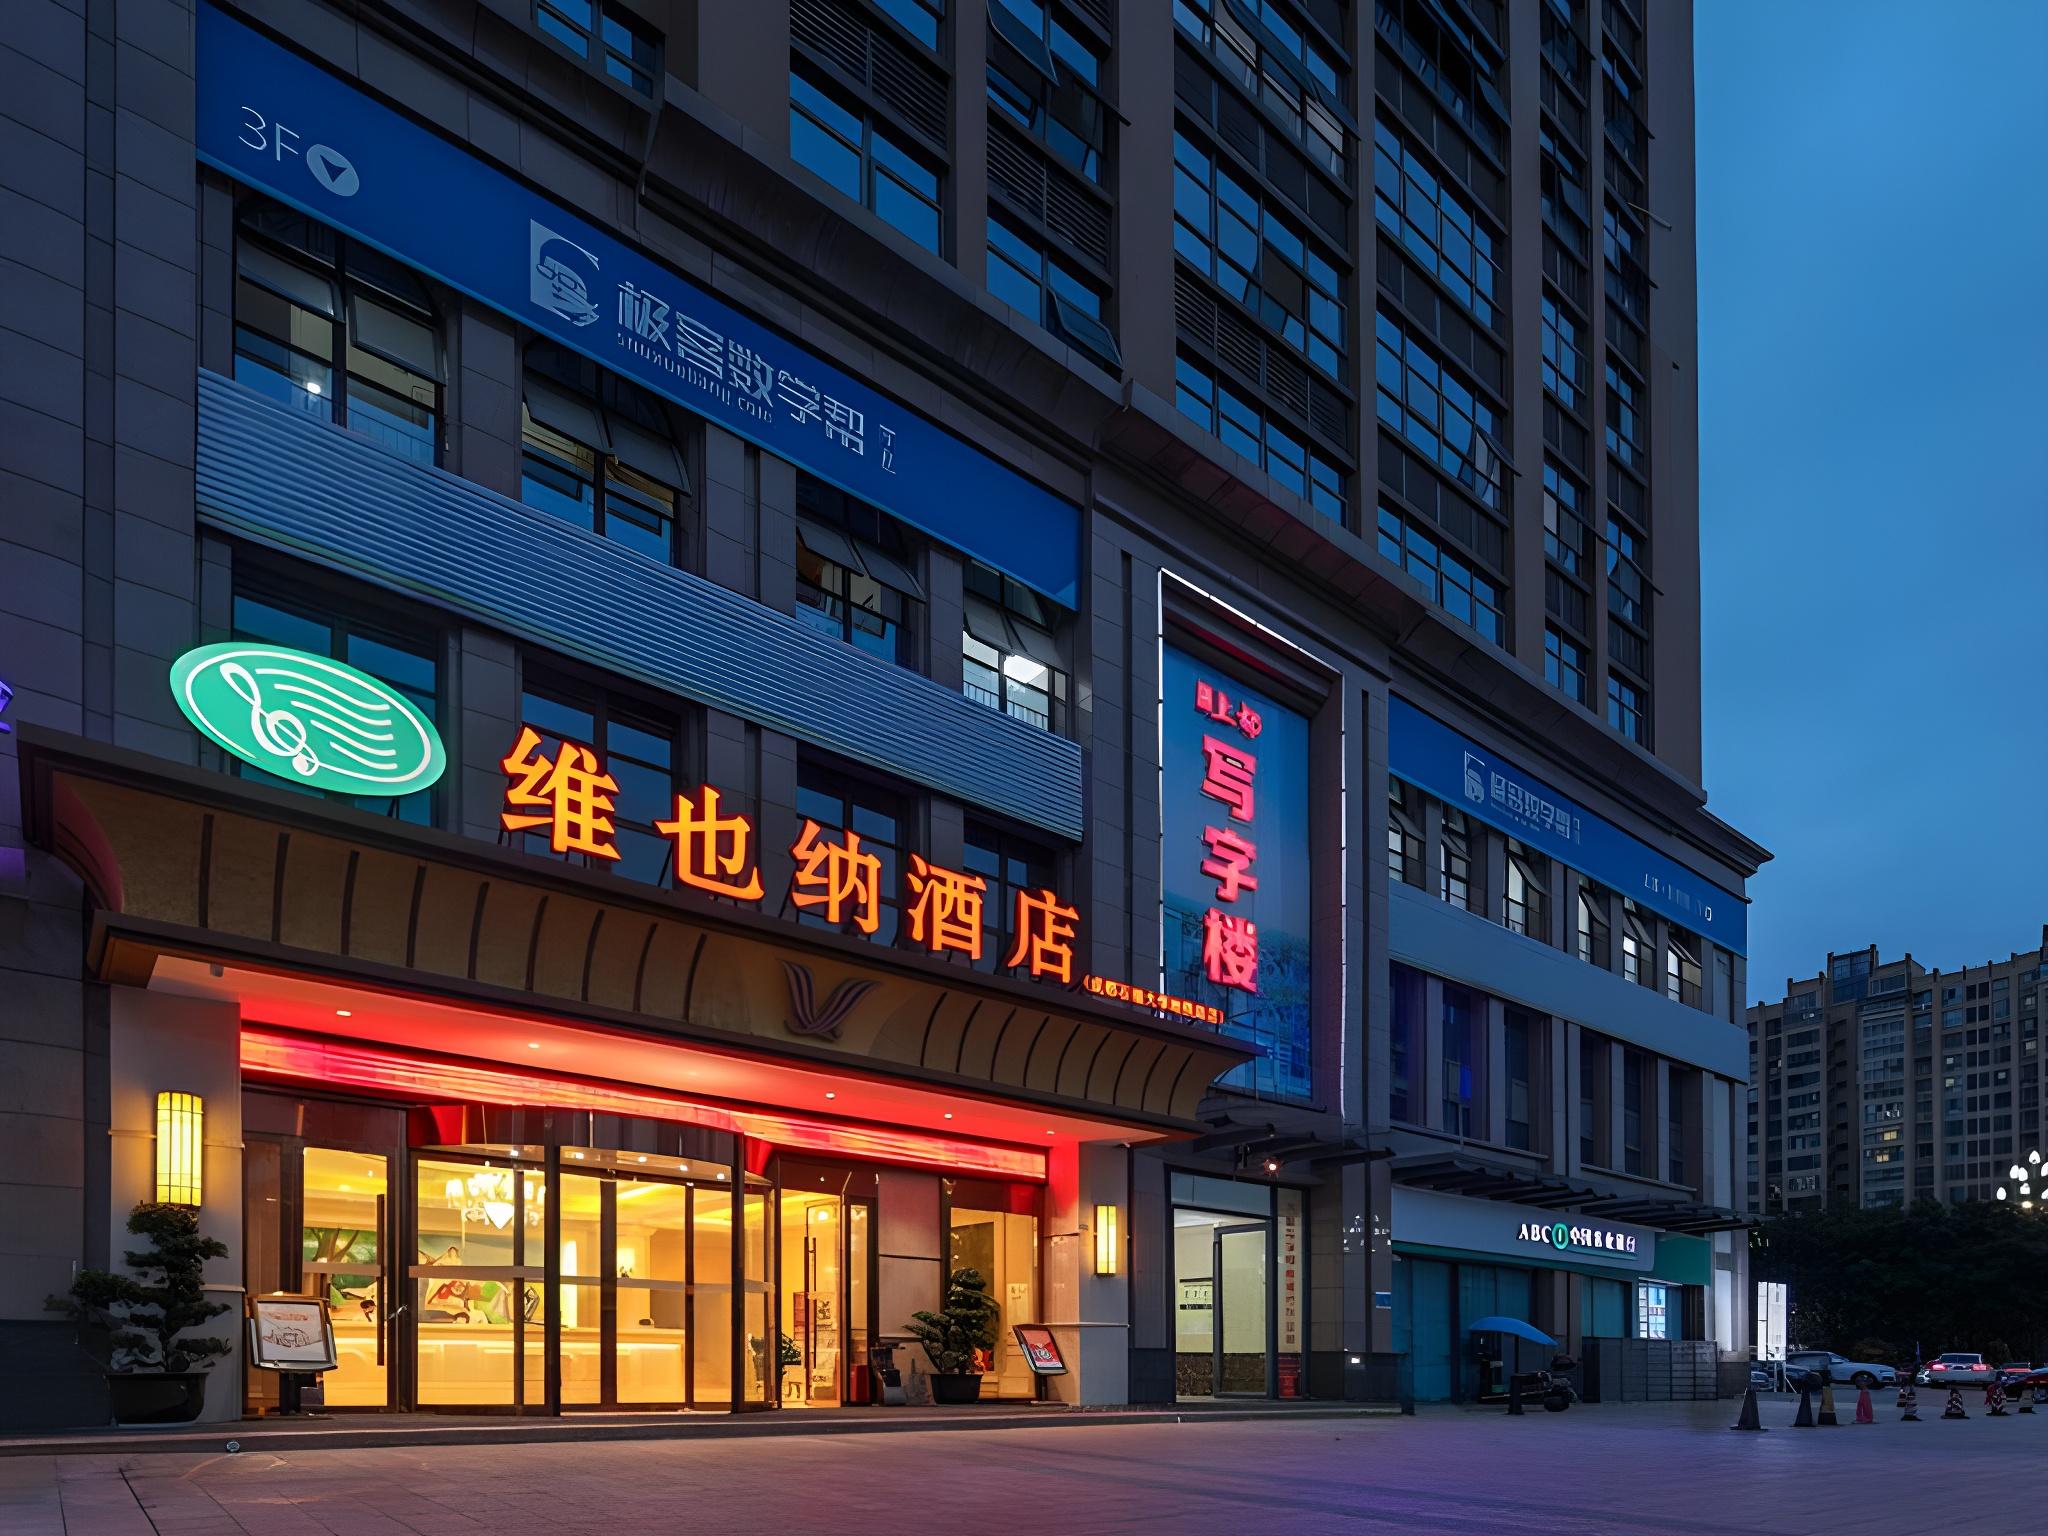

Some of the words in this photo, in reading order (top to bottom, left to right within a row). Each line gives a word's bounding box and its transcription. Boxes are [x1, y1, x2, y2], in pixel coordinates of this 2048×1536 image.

[237, 105, 300, 162] 3F
[501, 725, 1081, 985] 维也纳酒店
[1200, 734, 1258, 993] 写字楼
[1518, 1223, 1551, 1244] ABC
